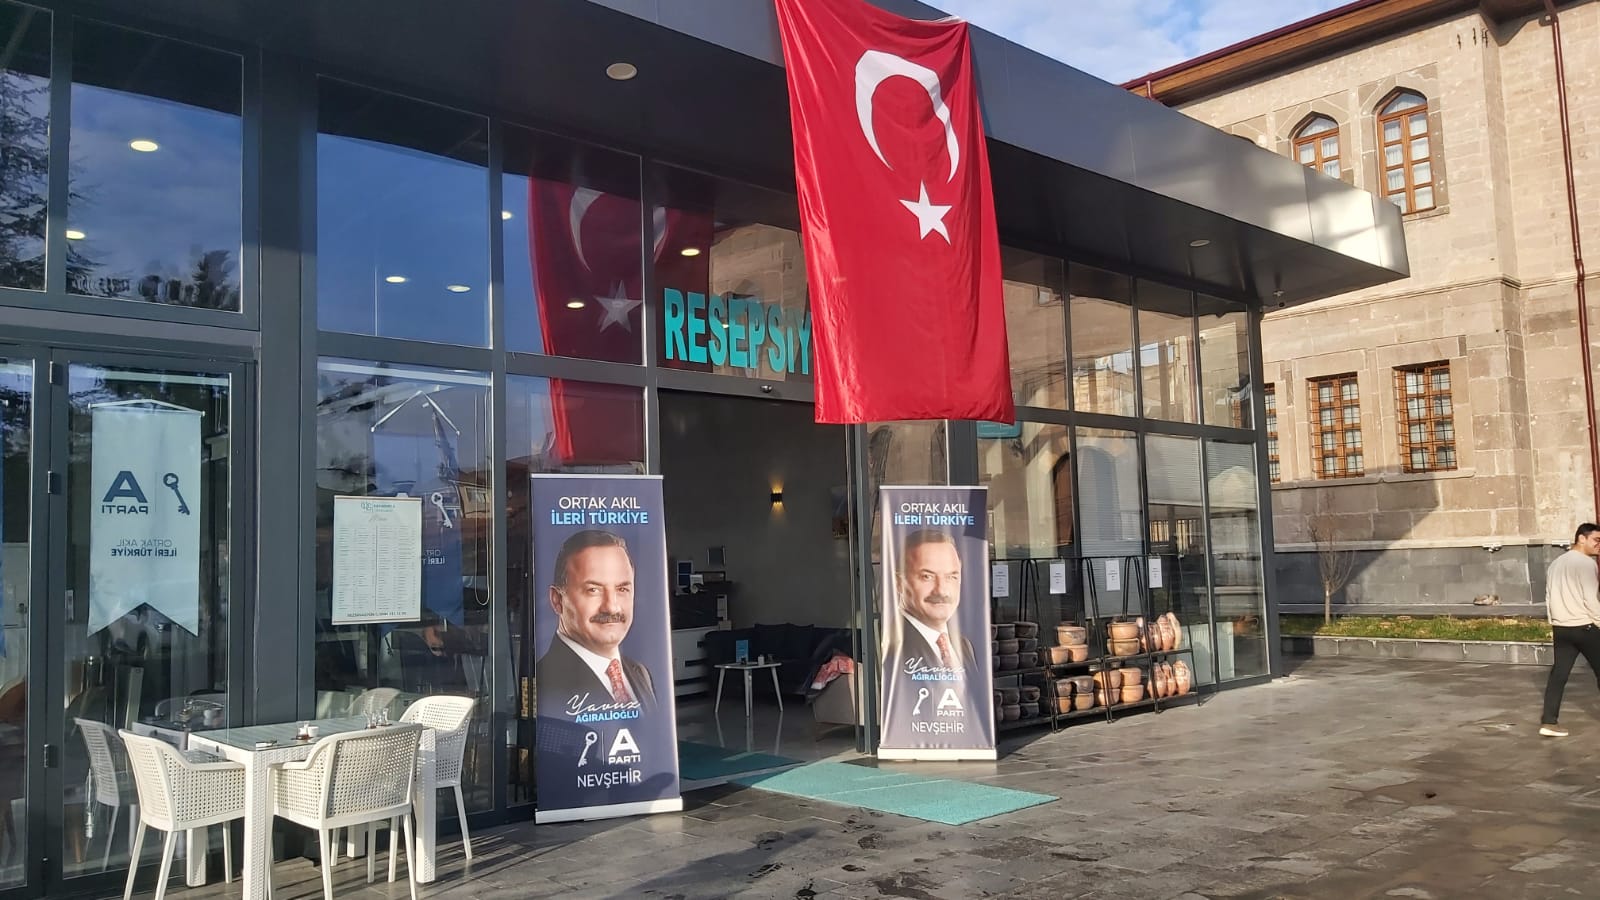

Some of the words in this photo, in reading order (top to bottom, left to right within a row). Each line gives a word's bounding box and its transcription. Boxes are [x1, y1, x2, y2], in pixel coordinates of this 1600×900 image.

[559, 497, 606, 509] ORTAK
[611, 496, 640, 509] AKIL
[901, 503, 940, 513] ORTAK
[943, 503, 969, 513] AKIL
[551, 509, 584, 525] İLERİ
[589, 510, 648, 524] TÜRKİYE
[895, 513, 921, 525] İLERİ
[925, 513, 974, 525] TÜRKİYE
[566, 692, 641, 716] Yavuz
[937, 688, 964, 709] A
[575, 710, 639, 723] AĞIRALİOĞLU
[911, 720, 965, 735] NEVŞEHİR
[608, 728, 641, 756] A
[577, 768, 642, 789] NEVŞEHİR
